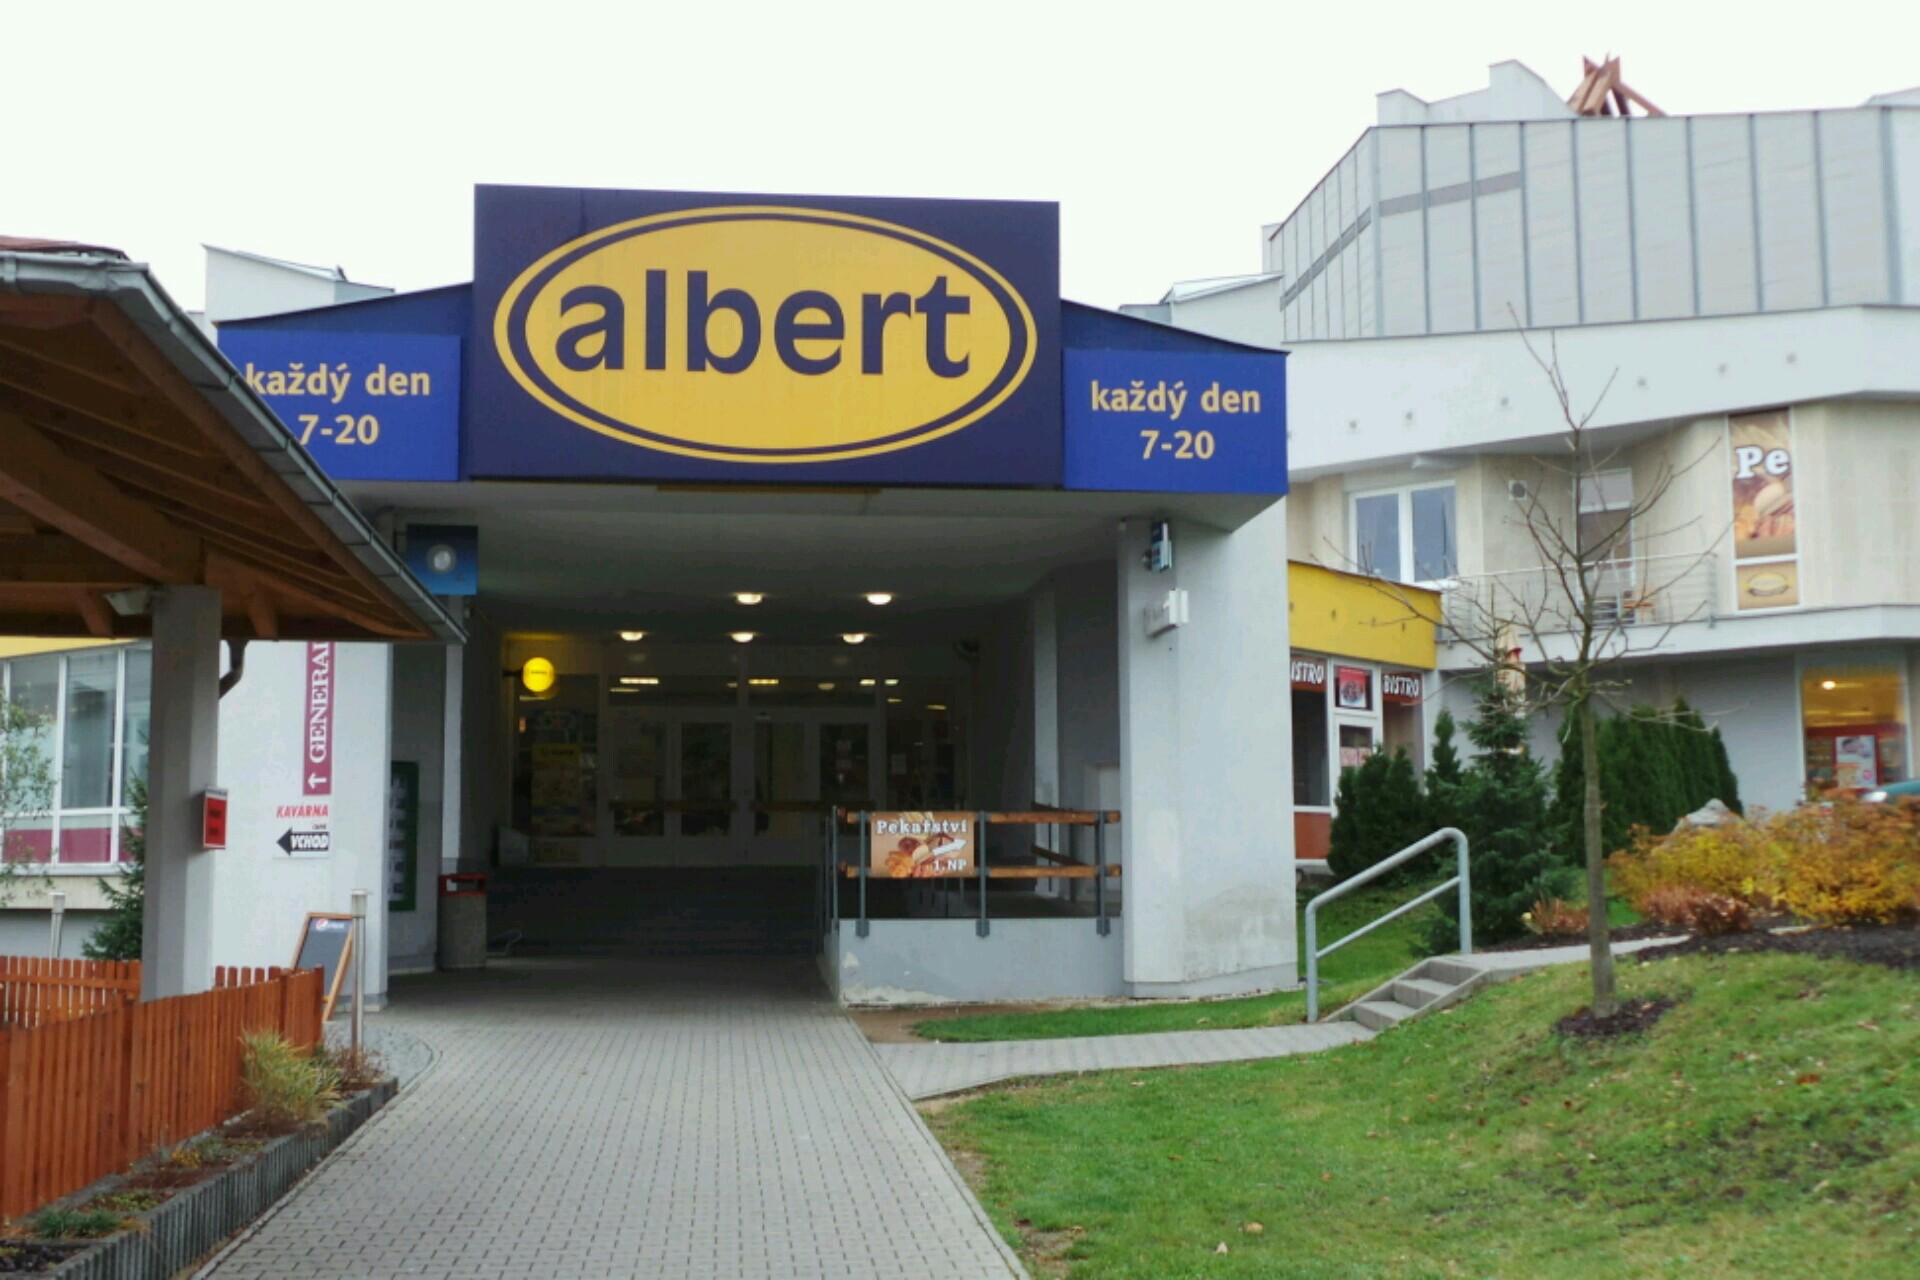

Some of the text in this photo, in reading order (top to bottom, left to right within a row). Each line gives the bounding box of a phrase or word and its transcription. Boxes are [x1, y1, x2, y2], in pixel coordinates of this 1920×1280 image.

[555, 269, 971, 379] albert
[246, 363, 430, 403] každý den
[1091, 380, 1261, 420] každý den
[298, 414, 380, 445] 7-20
[1140, 431, 1215, 460] 7-20
[1734, 446, 1790, 479] Pe
